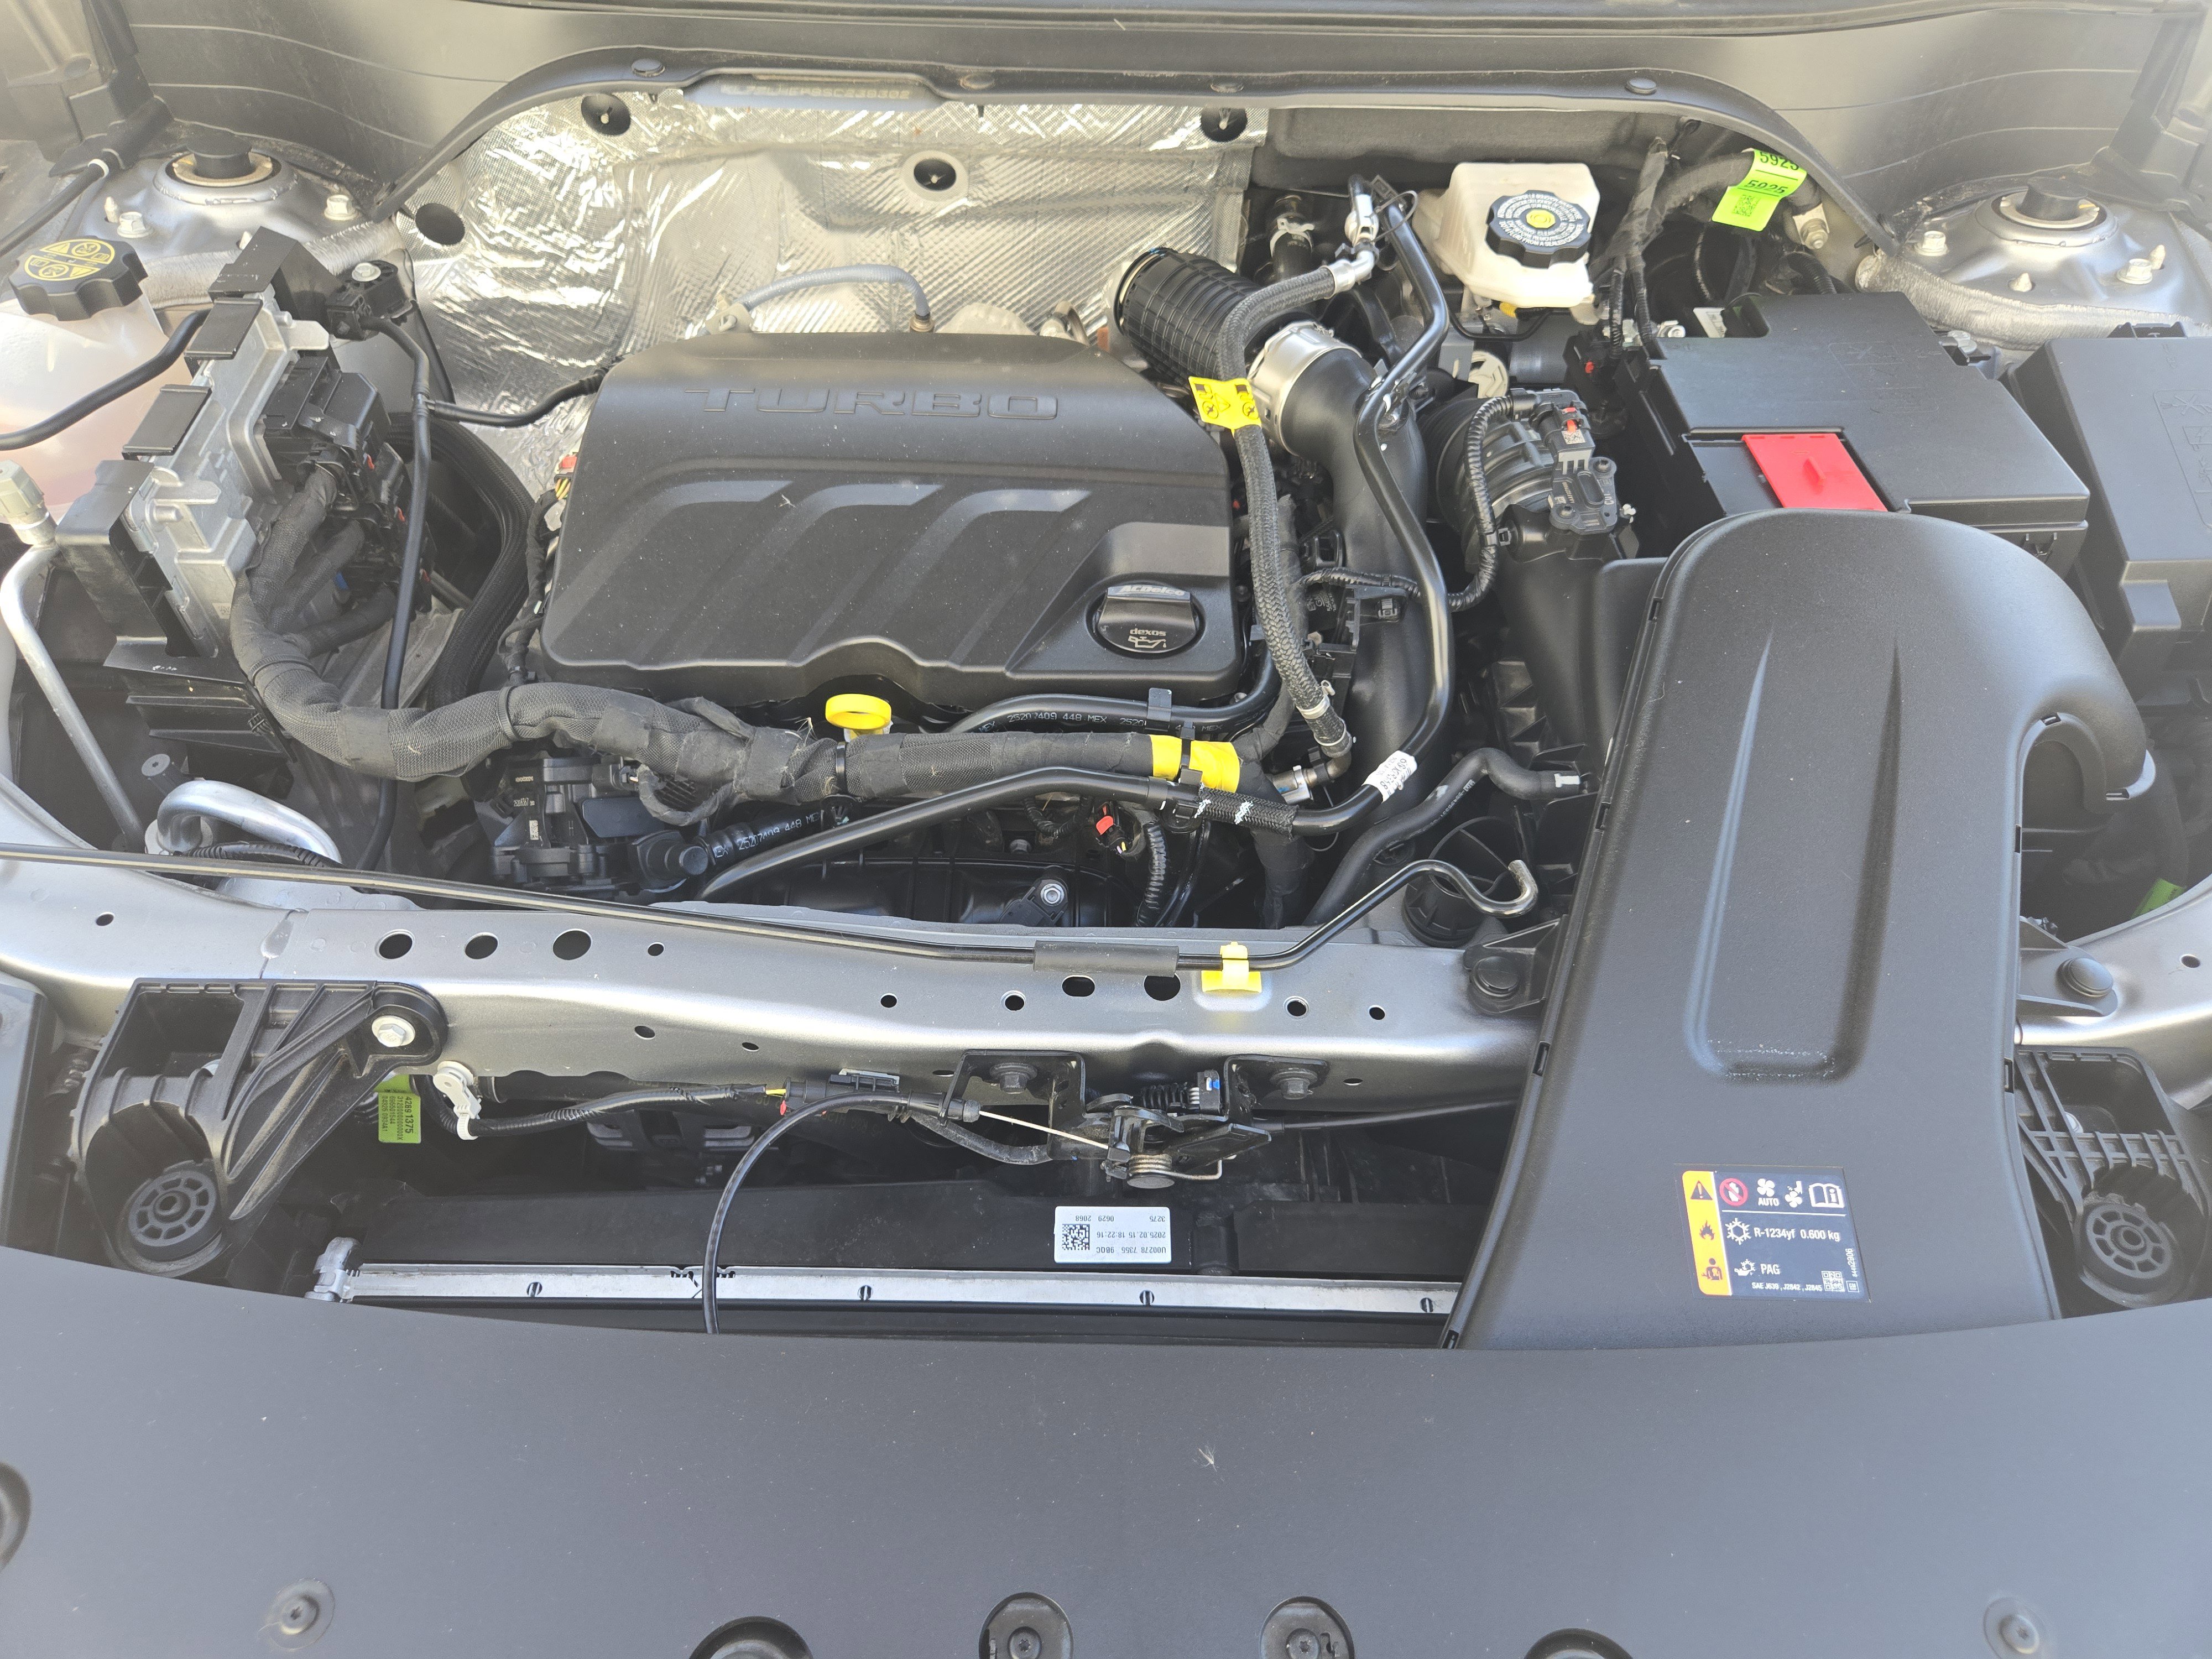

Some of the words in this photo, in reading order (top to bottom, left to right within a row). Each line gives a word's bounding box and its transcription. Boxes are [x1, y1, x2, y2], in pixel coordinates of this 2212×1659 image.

[684, 387, 1058, 420] TURBO
[1119, 585, 1185, 596] ACDelco
[1129, 628, 1167, 637] dexos
[1062, 713, 1082, 722] 448
[1088, 714, 1107, 723] MEX
[785, 818, 802, 832] 448
[806, 812, 820, 825] ME
[404, 1097, 413, 1113] 4289
[405, 1114, 414, 1134] 1375
[1757, 1198, 1780, 1207] AUTO
[1754, 1227, 1796, 1240] R-1234yf
[1800, 1229, 1827, 1240] 0.600
[1828, 1230, 1840, 1242] kg
[1760, 1263, 1781, 1275] PAG
